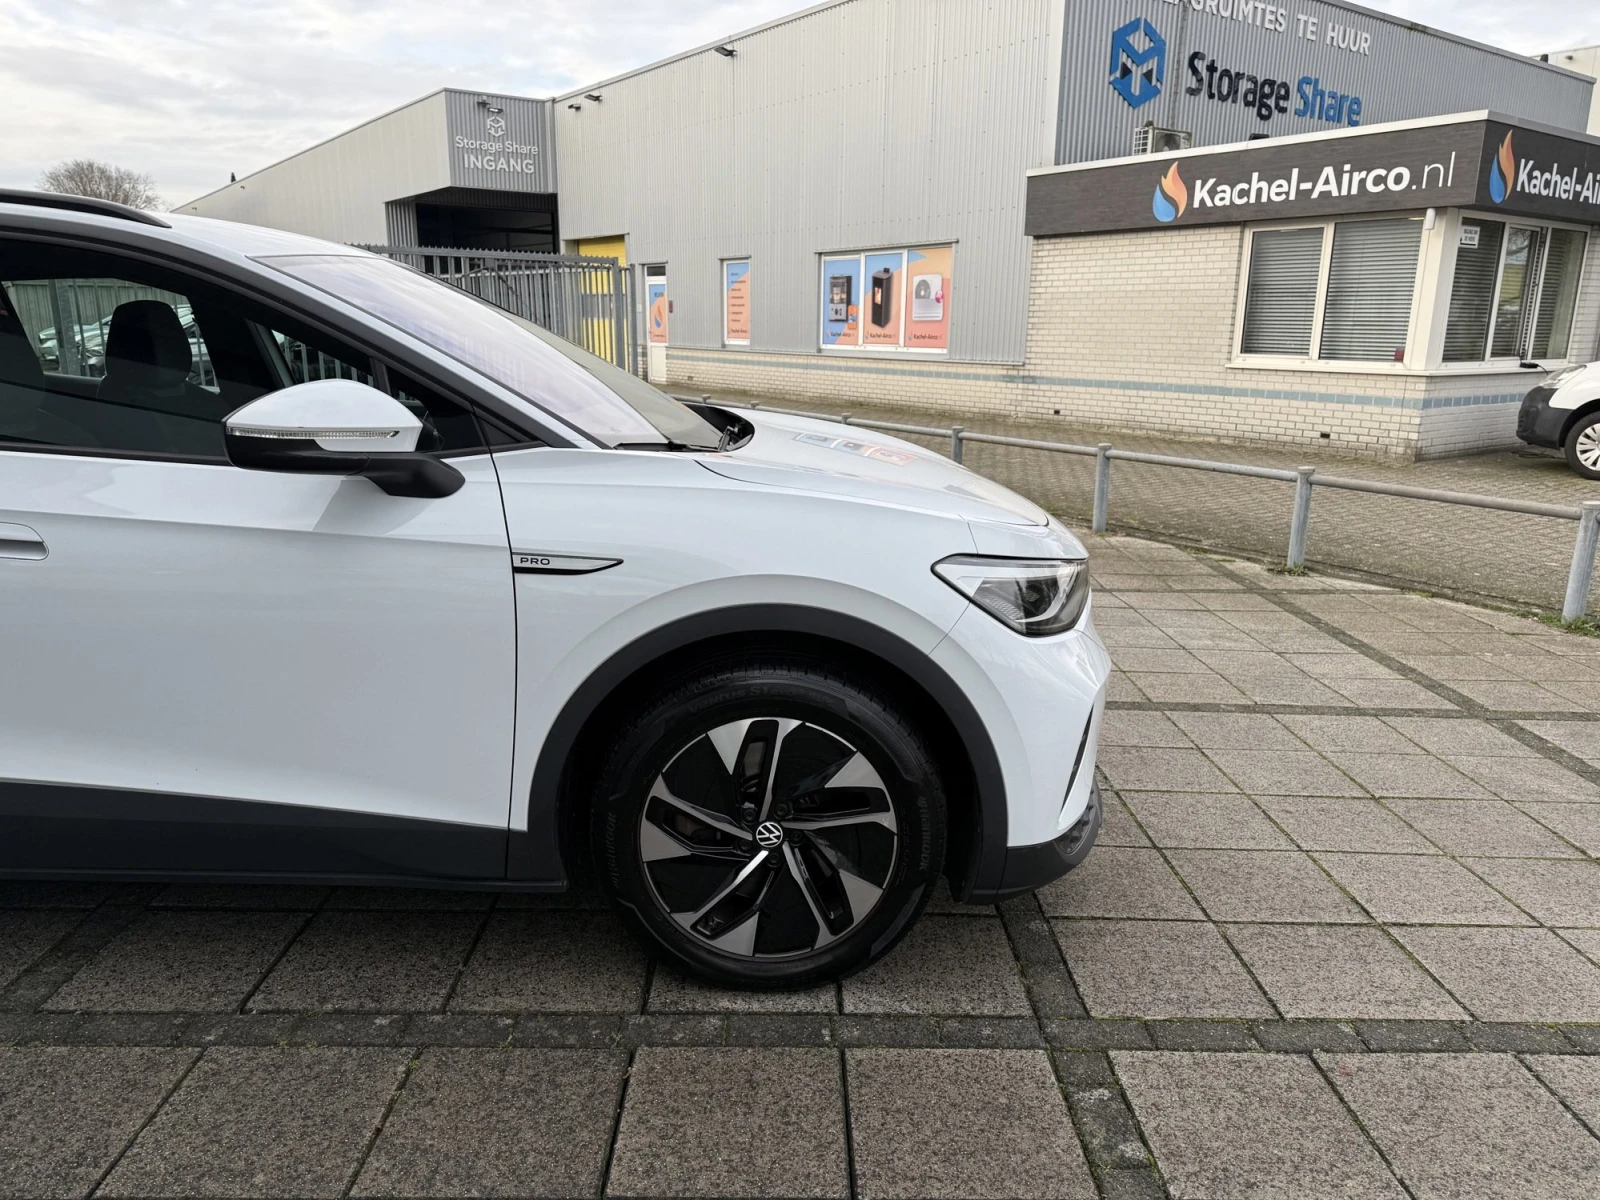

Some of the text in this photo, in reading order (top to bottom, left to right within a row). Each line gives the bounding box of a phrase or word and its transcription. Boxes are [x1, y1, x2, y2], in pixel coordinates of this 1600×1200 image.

[1162, 0, 1371, 55] RUIMTES TE HUUR
[1186, 51, 1362, 126] Storage Share
[455, 135, 539, 155] Storage Share
[464, 153, 535, 174] INGANG
[1193, 151, 1456, 208] Kachel-Airco.nl
[520, 556, 551, 566] PRO
